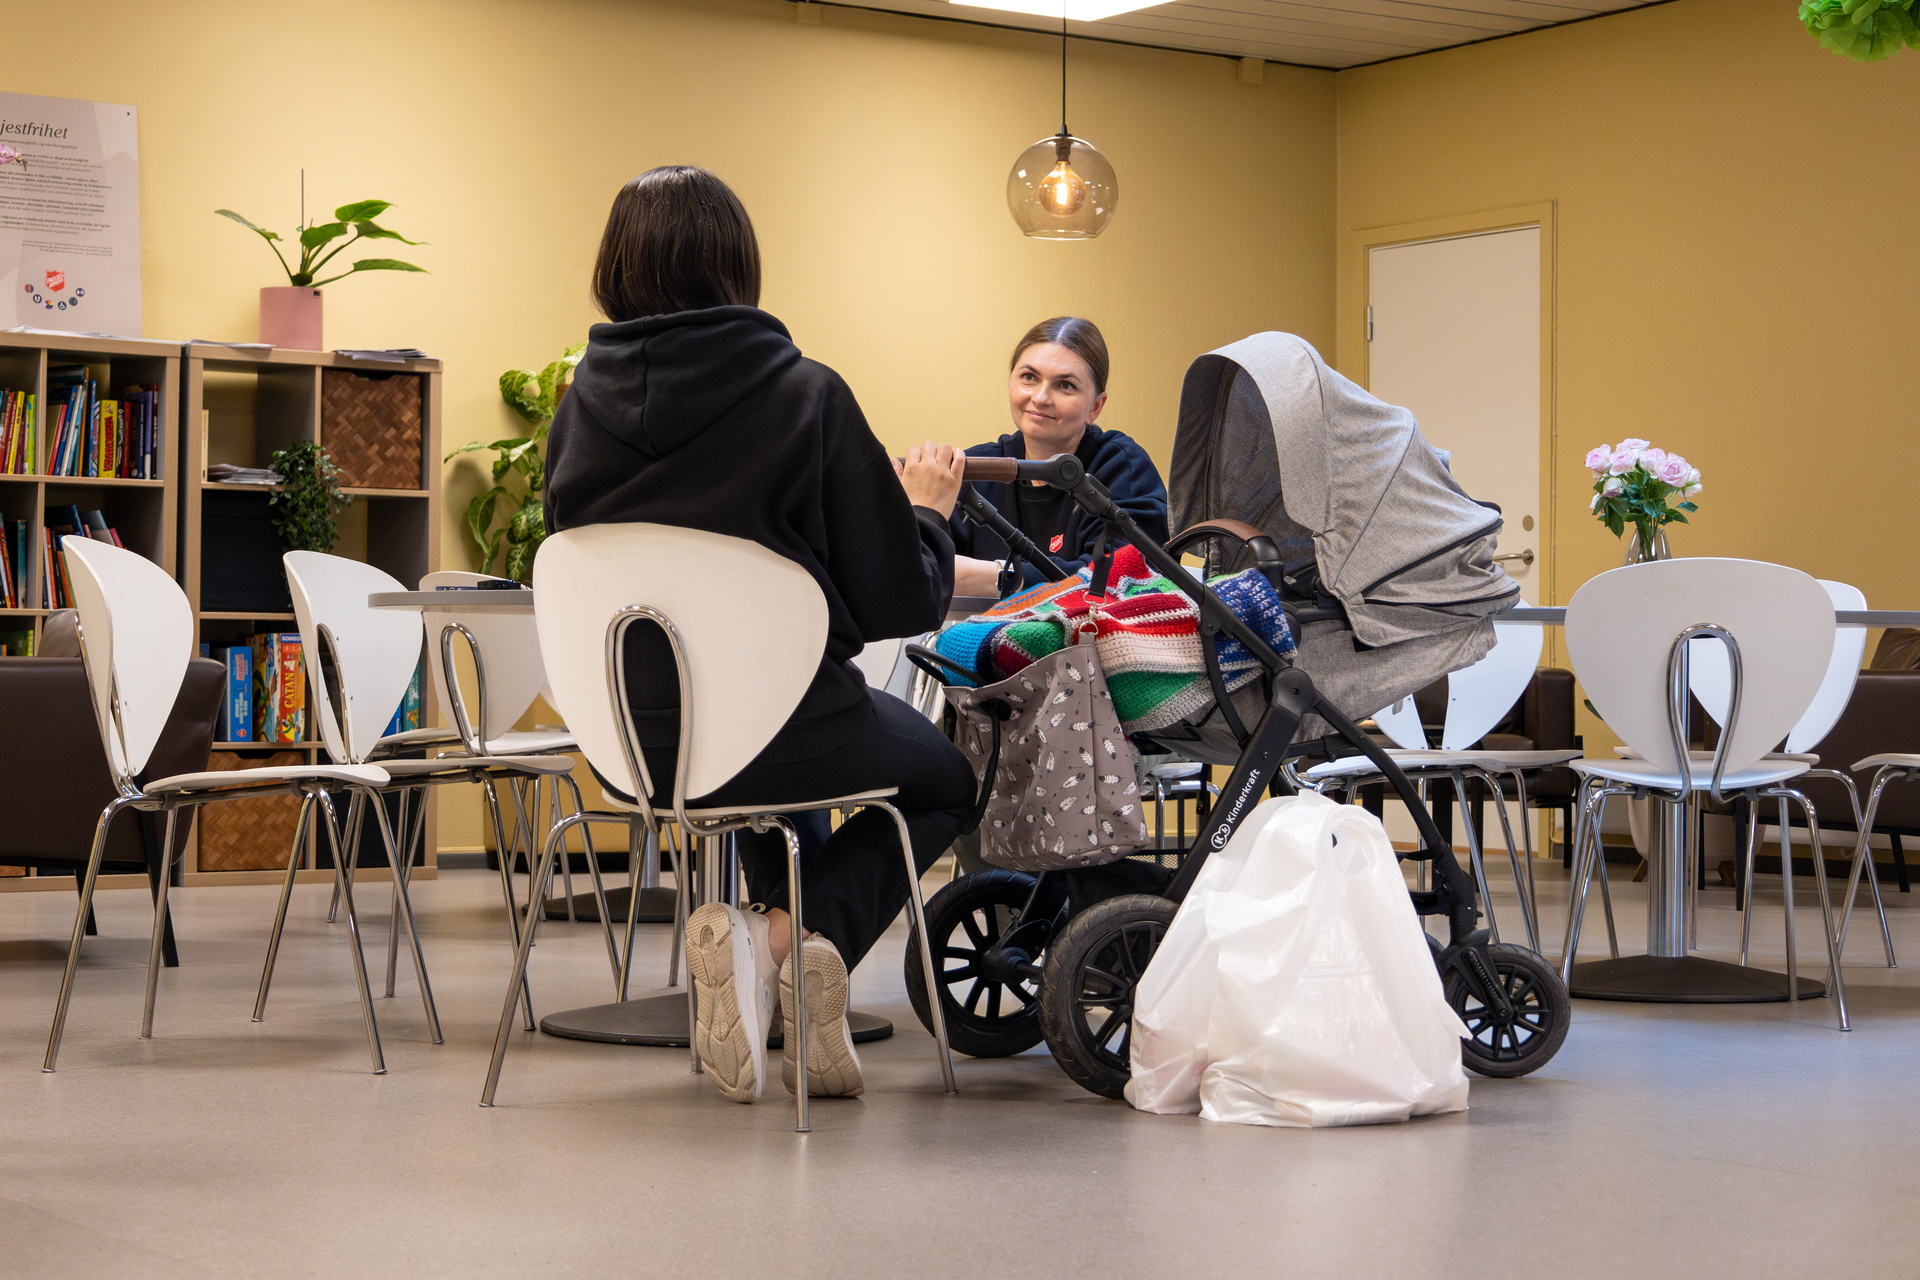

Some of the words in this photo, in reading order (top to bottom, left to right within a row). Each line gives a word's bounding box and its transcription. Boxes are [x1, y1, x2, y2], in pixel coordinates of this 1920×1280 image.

[103, 415, 115, 472] VITSEBONANZA
[284, 672, 295, 708] CATAN
[1226, 768, 1261, 824] Kinderkraft
